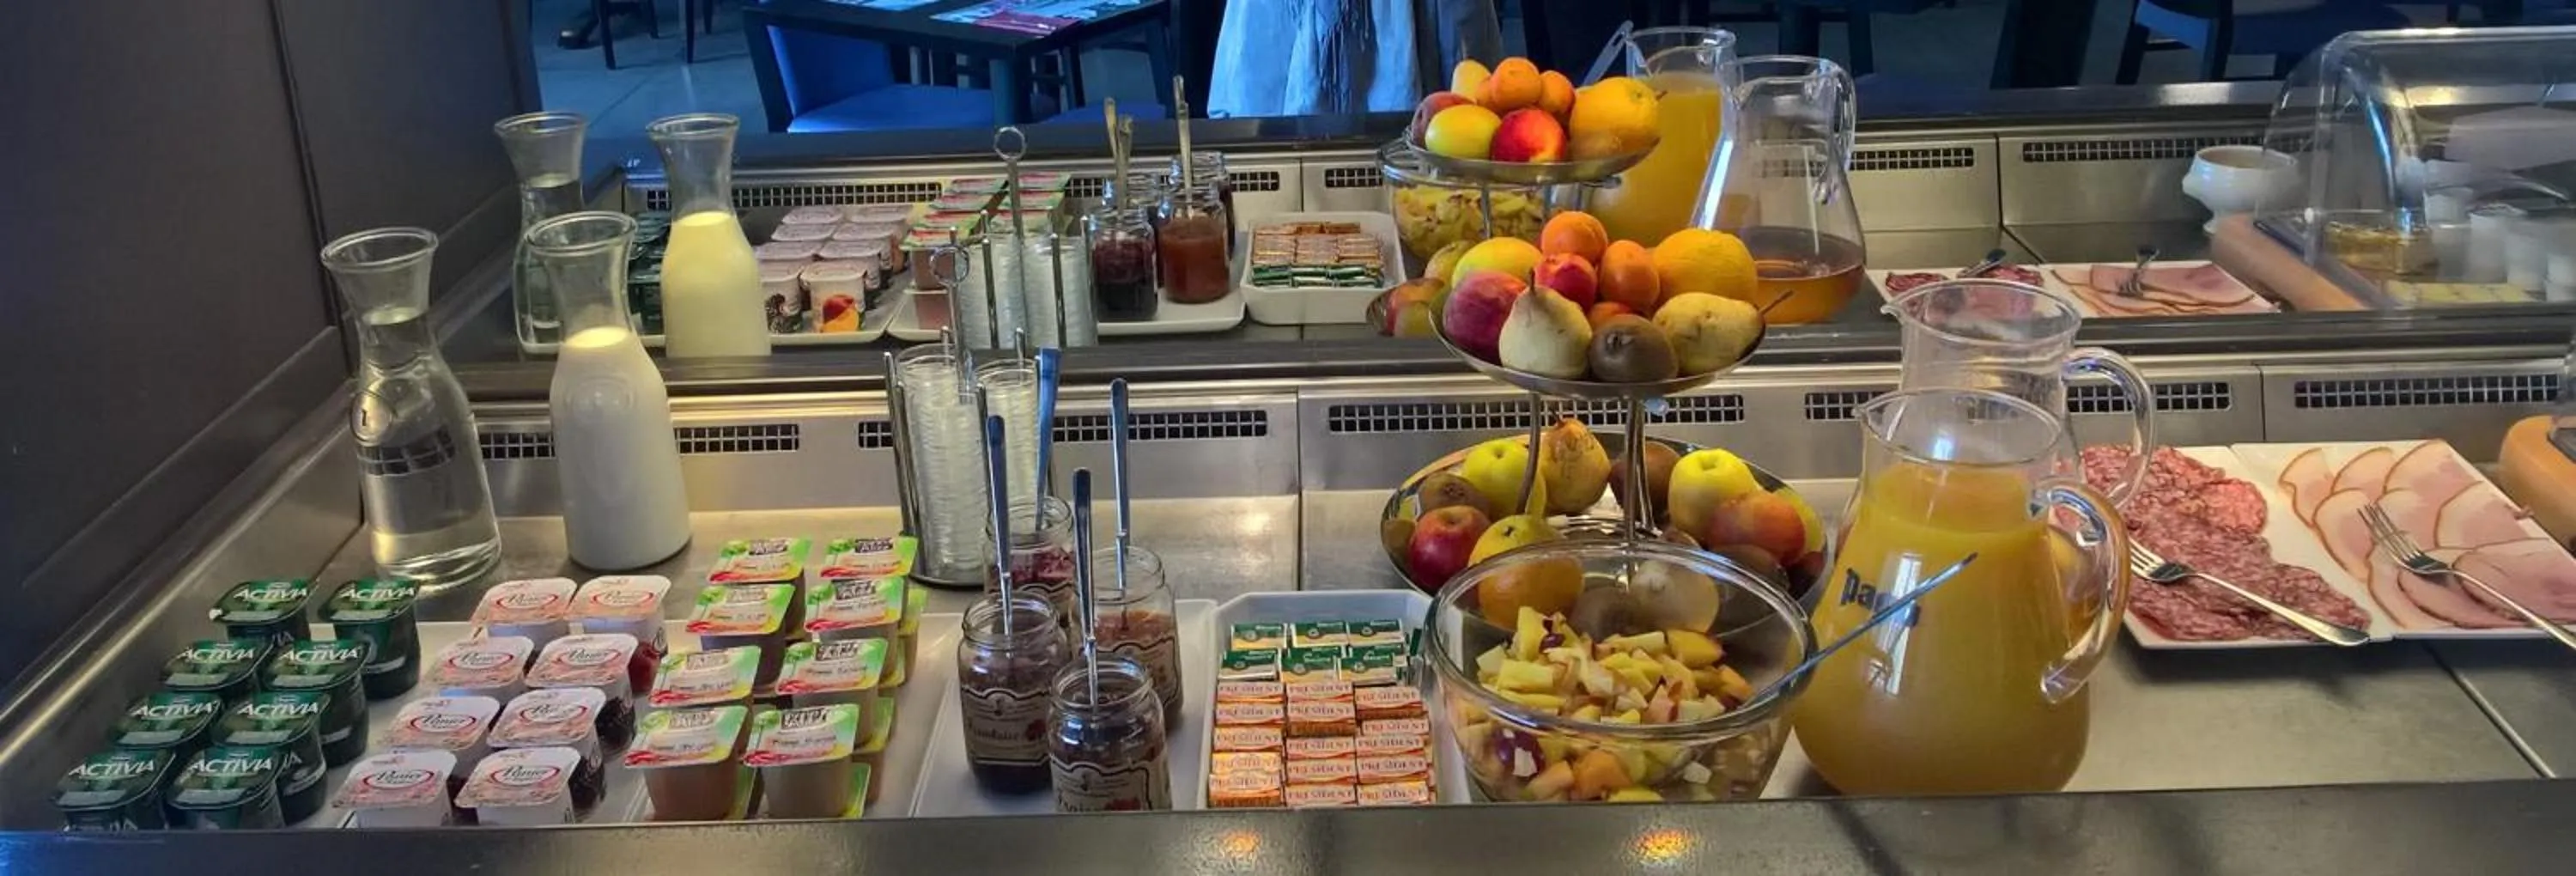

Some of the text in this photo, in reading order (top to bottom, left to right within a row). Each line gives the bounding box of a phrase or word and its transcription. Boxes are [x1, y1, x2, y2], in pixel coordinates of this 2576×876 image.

[233, 586, 308, 601] ACTIVIA
[339, 586, 416, 601] ACTIVIA
[176, 646, 255, 661] ACTIVIA
[279, 647, 359, 662] ACTIVIA
[129, 701, 213, 717] ACTIVIA
[237, 700, 319, 717] ACTIVIA
[68, 758, 155, 776] ACTIVIA
[186, 756, 273, 774] ACTIVIA
